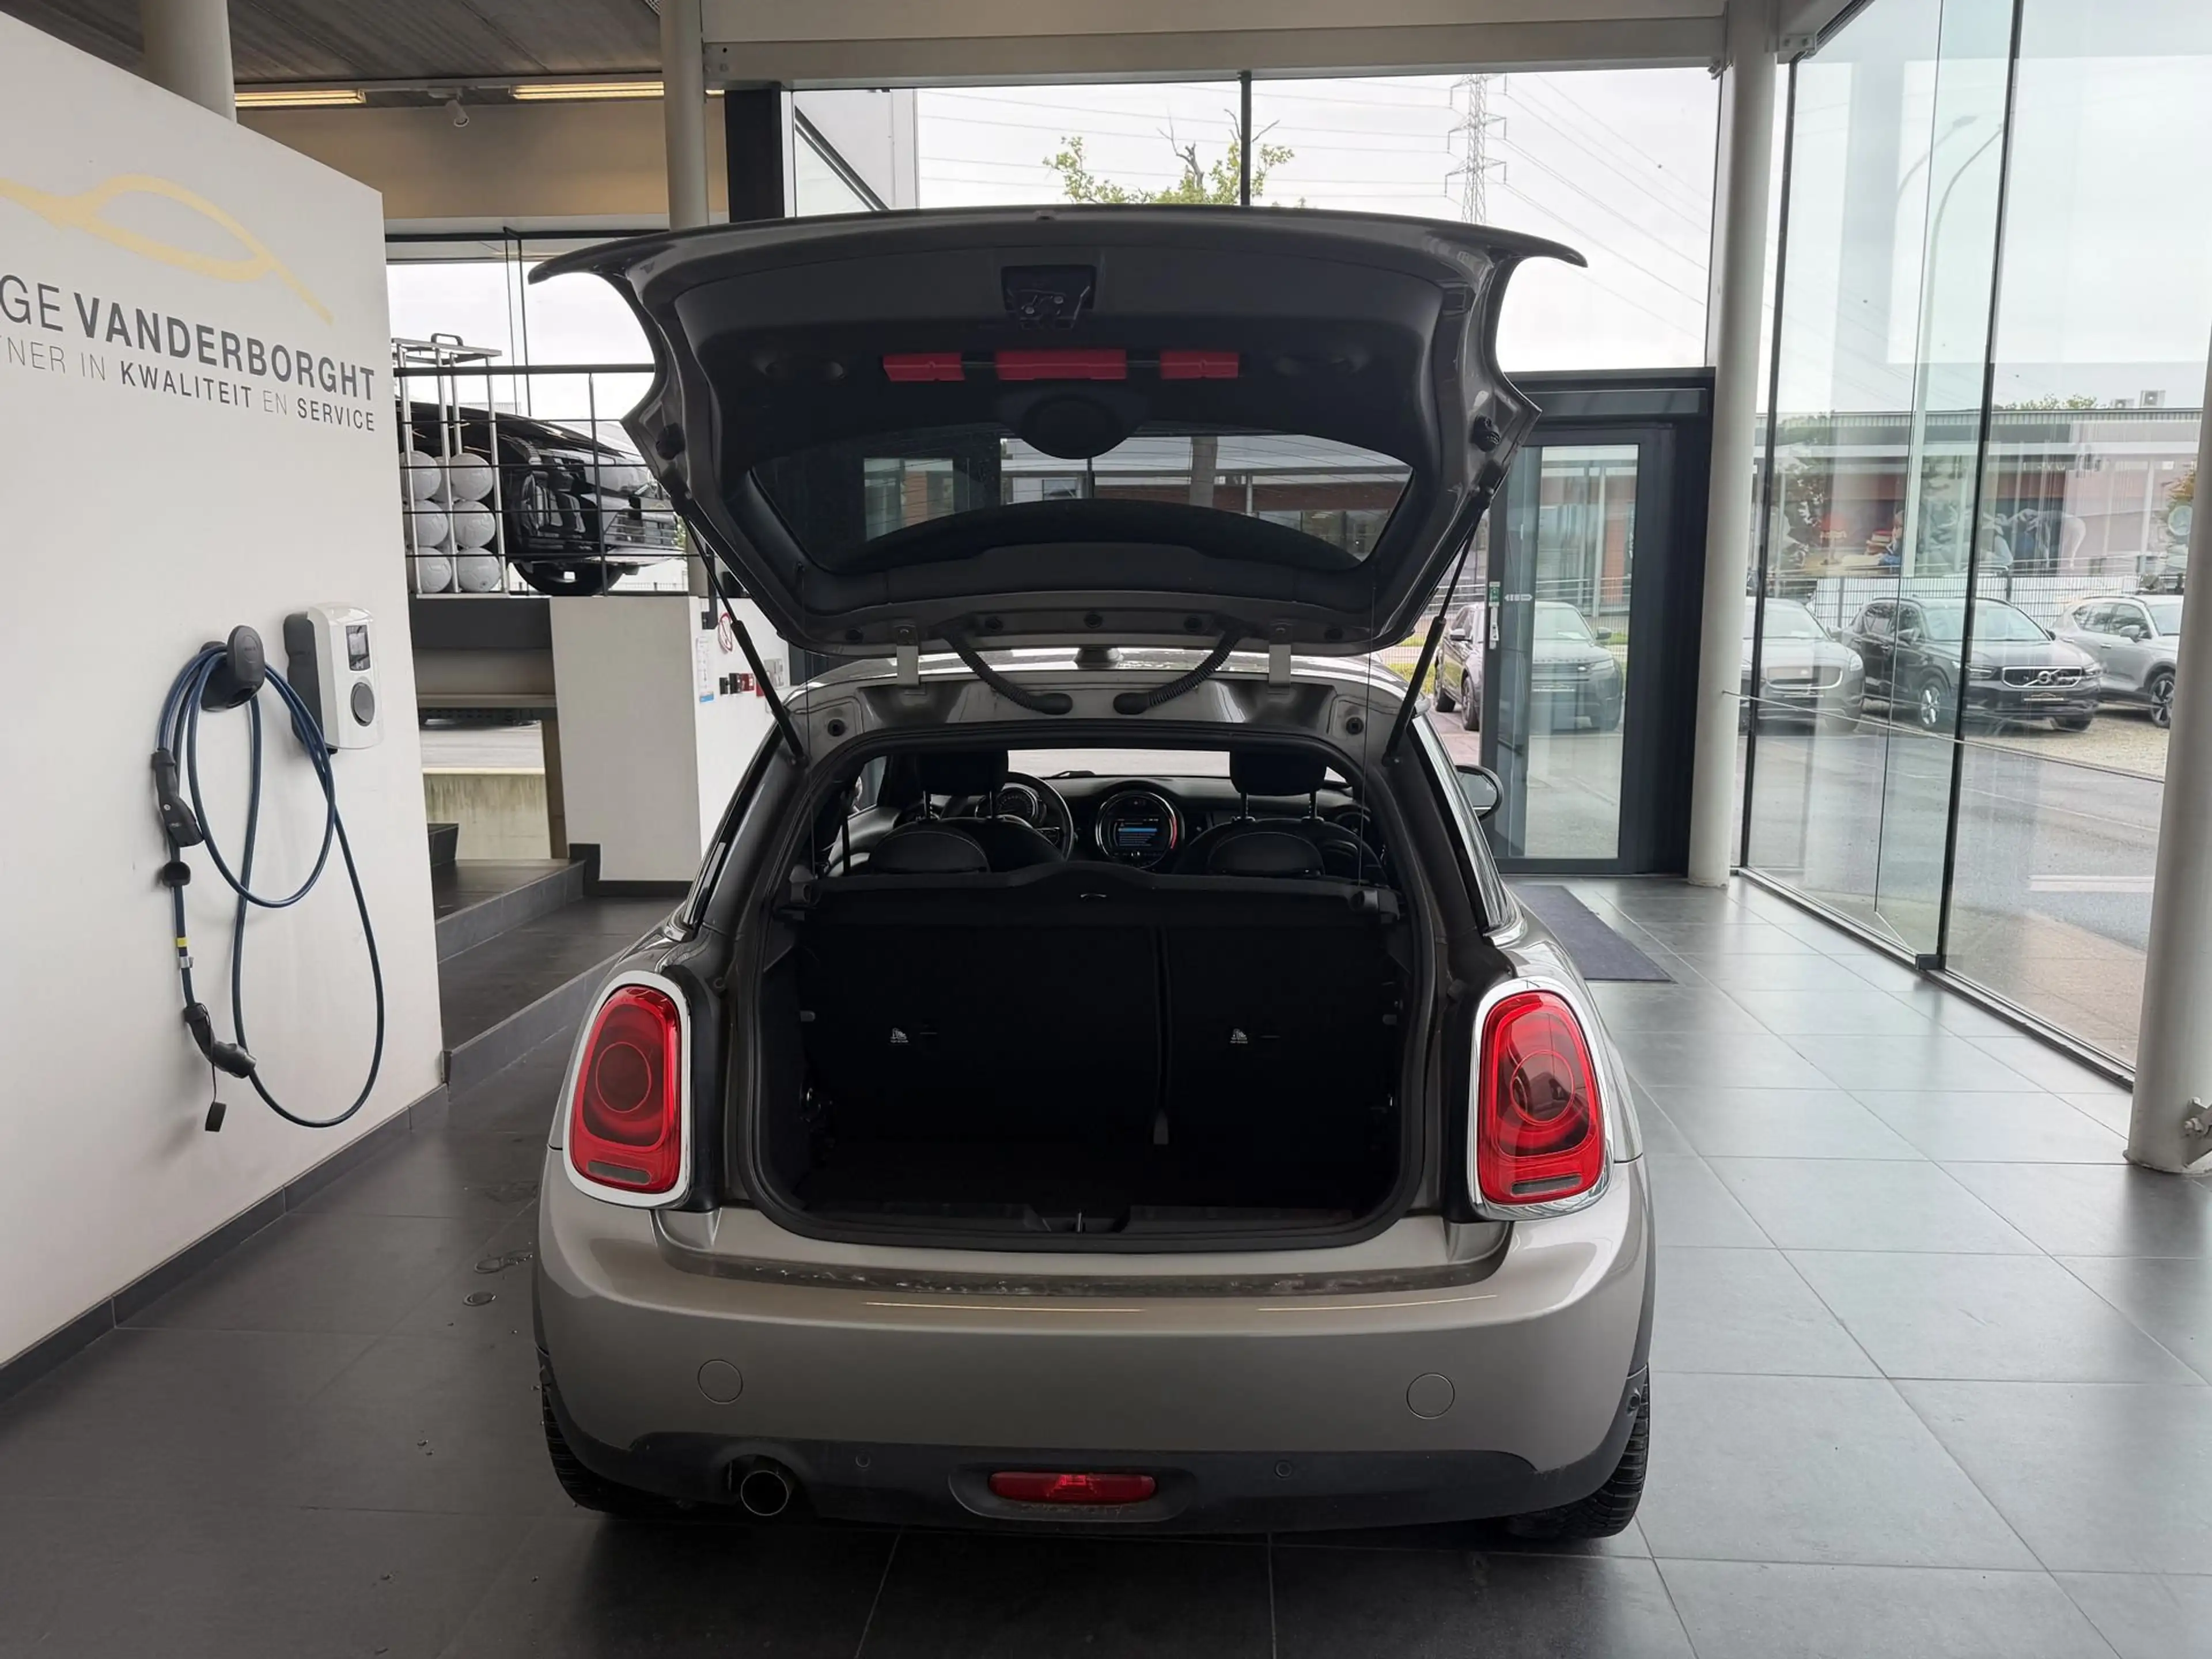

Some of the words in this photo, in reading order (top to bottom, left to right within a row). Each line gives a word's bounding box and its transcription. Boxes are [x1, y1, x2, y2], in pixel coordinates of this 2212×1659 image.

[0, 274, 63, 332] GE
[73, 292, 374, 400] VANDERBORGHT
[0, 334, 66, 374] NER
[81, 351, 105, 381] IN
[120, 361, 252, 407] KWALITEIT
[263, 390, 287, 415] EN
[297, 397, 375, 431] SERVICE
